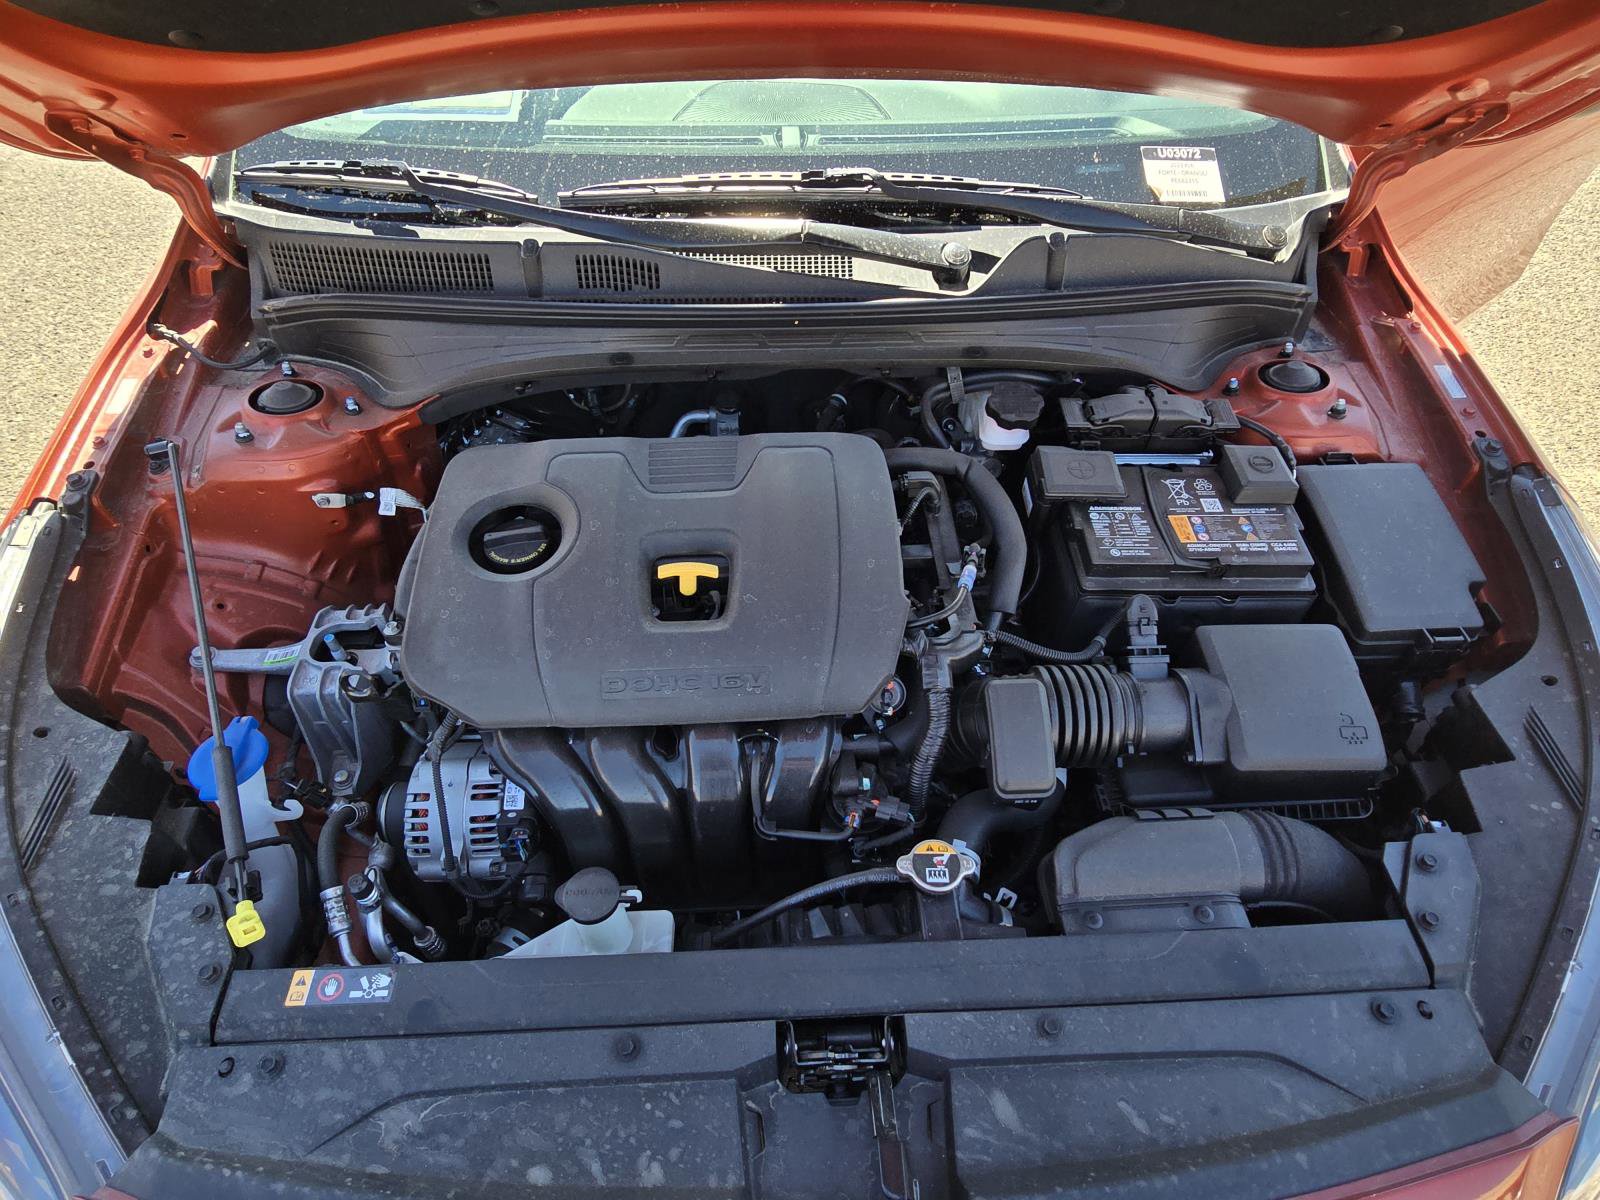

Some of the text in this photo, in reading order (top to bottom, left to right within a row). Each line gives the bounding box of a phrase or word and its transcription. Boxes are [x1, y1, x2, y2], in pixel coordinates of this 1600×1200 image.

[1157, 148, 1201, 159] U03072
[603, 672, 764, 693] DOHC 16V
